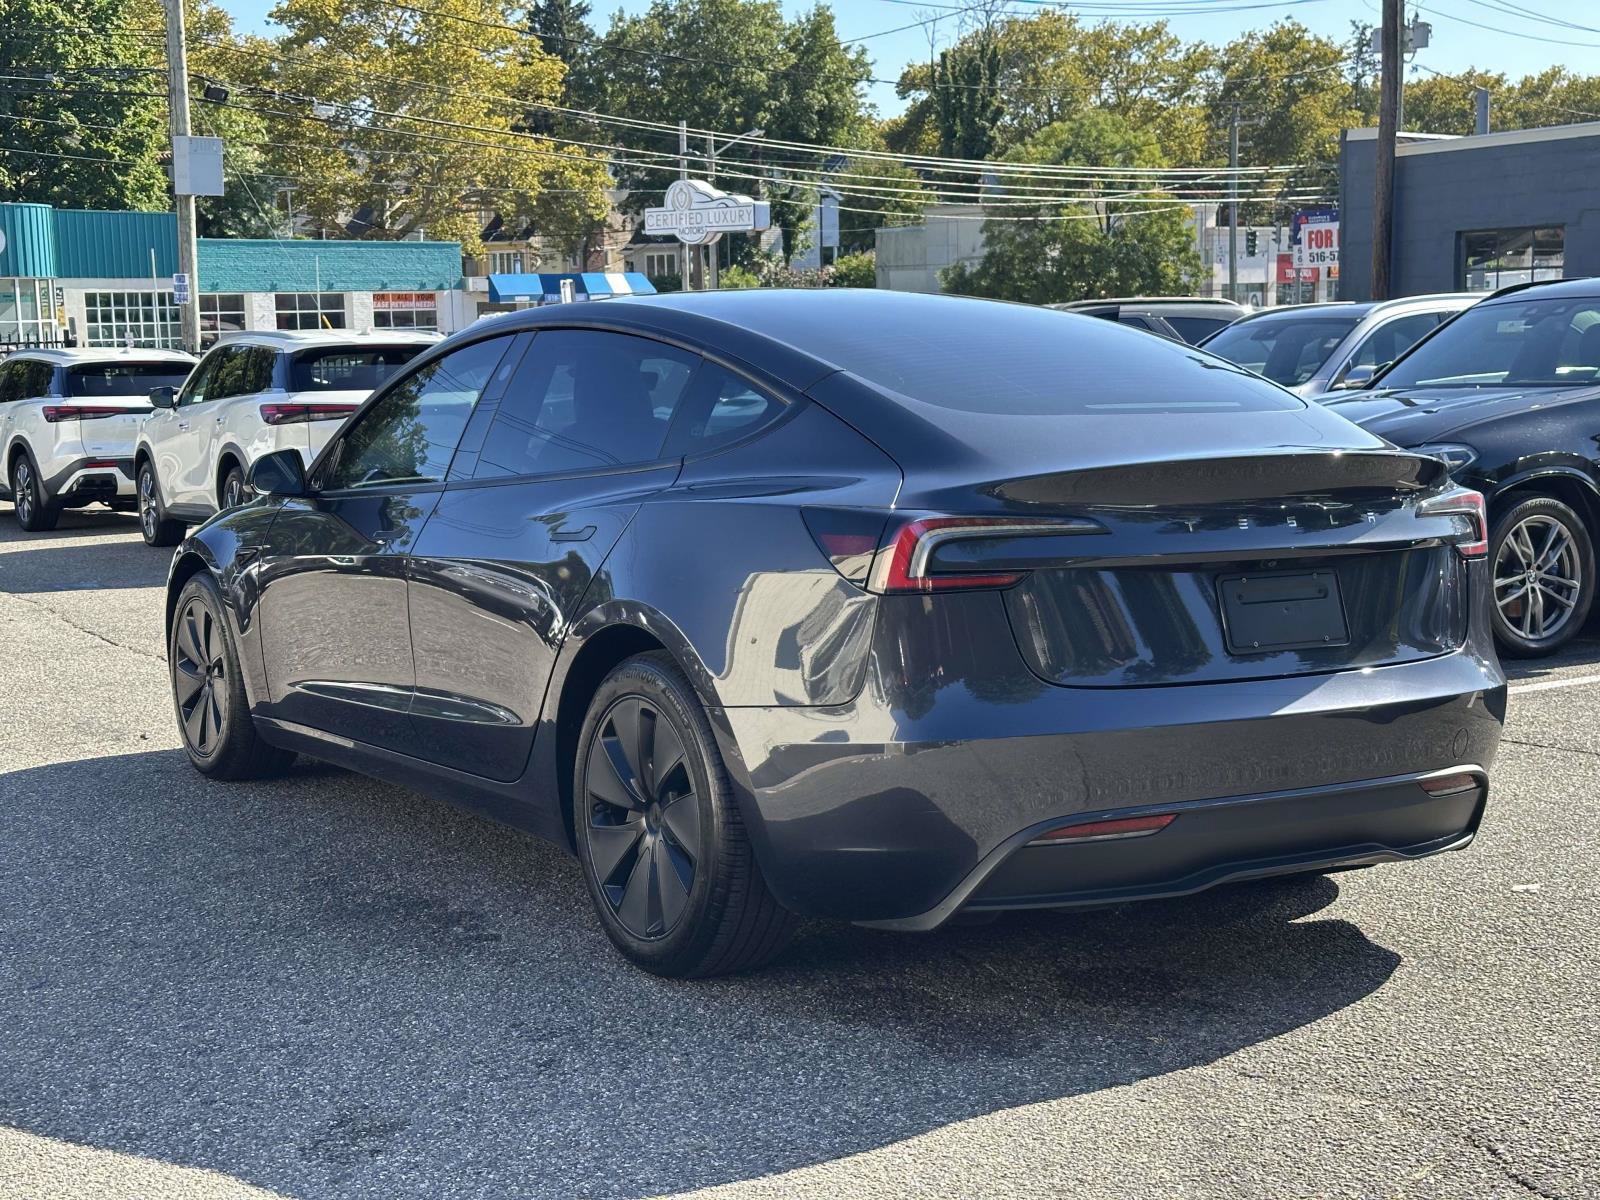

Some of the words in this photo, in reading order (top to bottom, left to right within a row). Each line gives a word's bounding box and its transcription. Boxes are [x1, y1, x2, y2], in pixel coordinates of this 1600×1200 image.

[646, 212, 702, 227] CERTIFIED
[708, 209, 752, 224] LUXURY
[680, 226, 705, 235] MOTORS
[1308, 229, 1333, 249] FOR
[1183, 511, 1377, 533] TESLA
